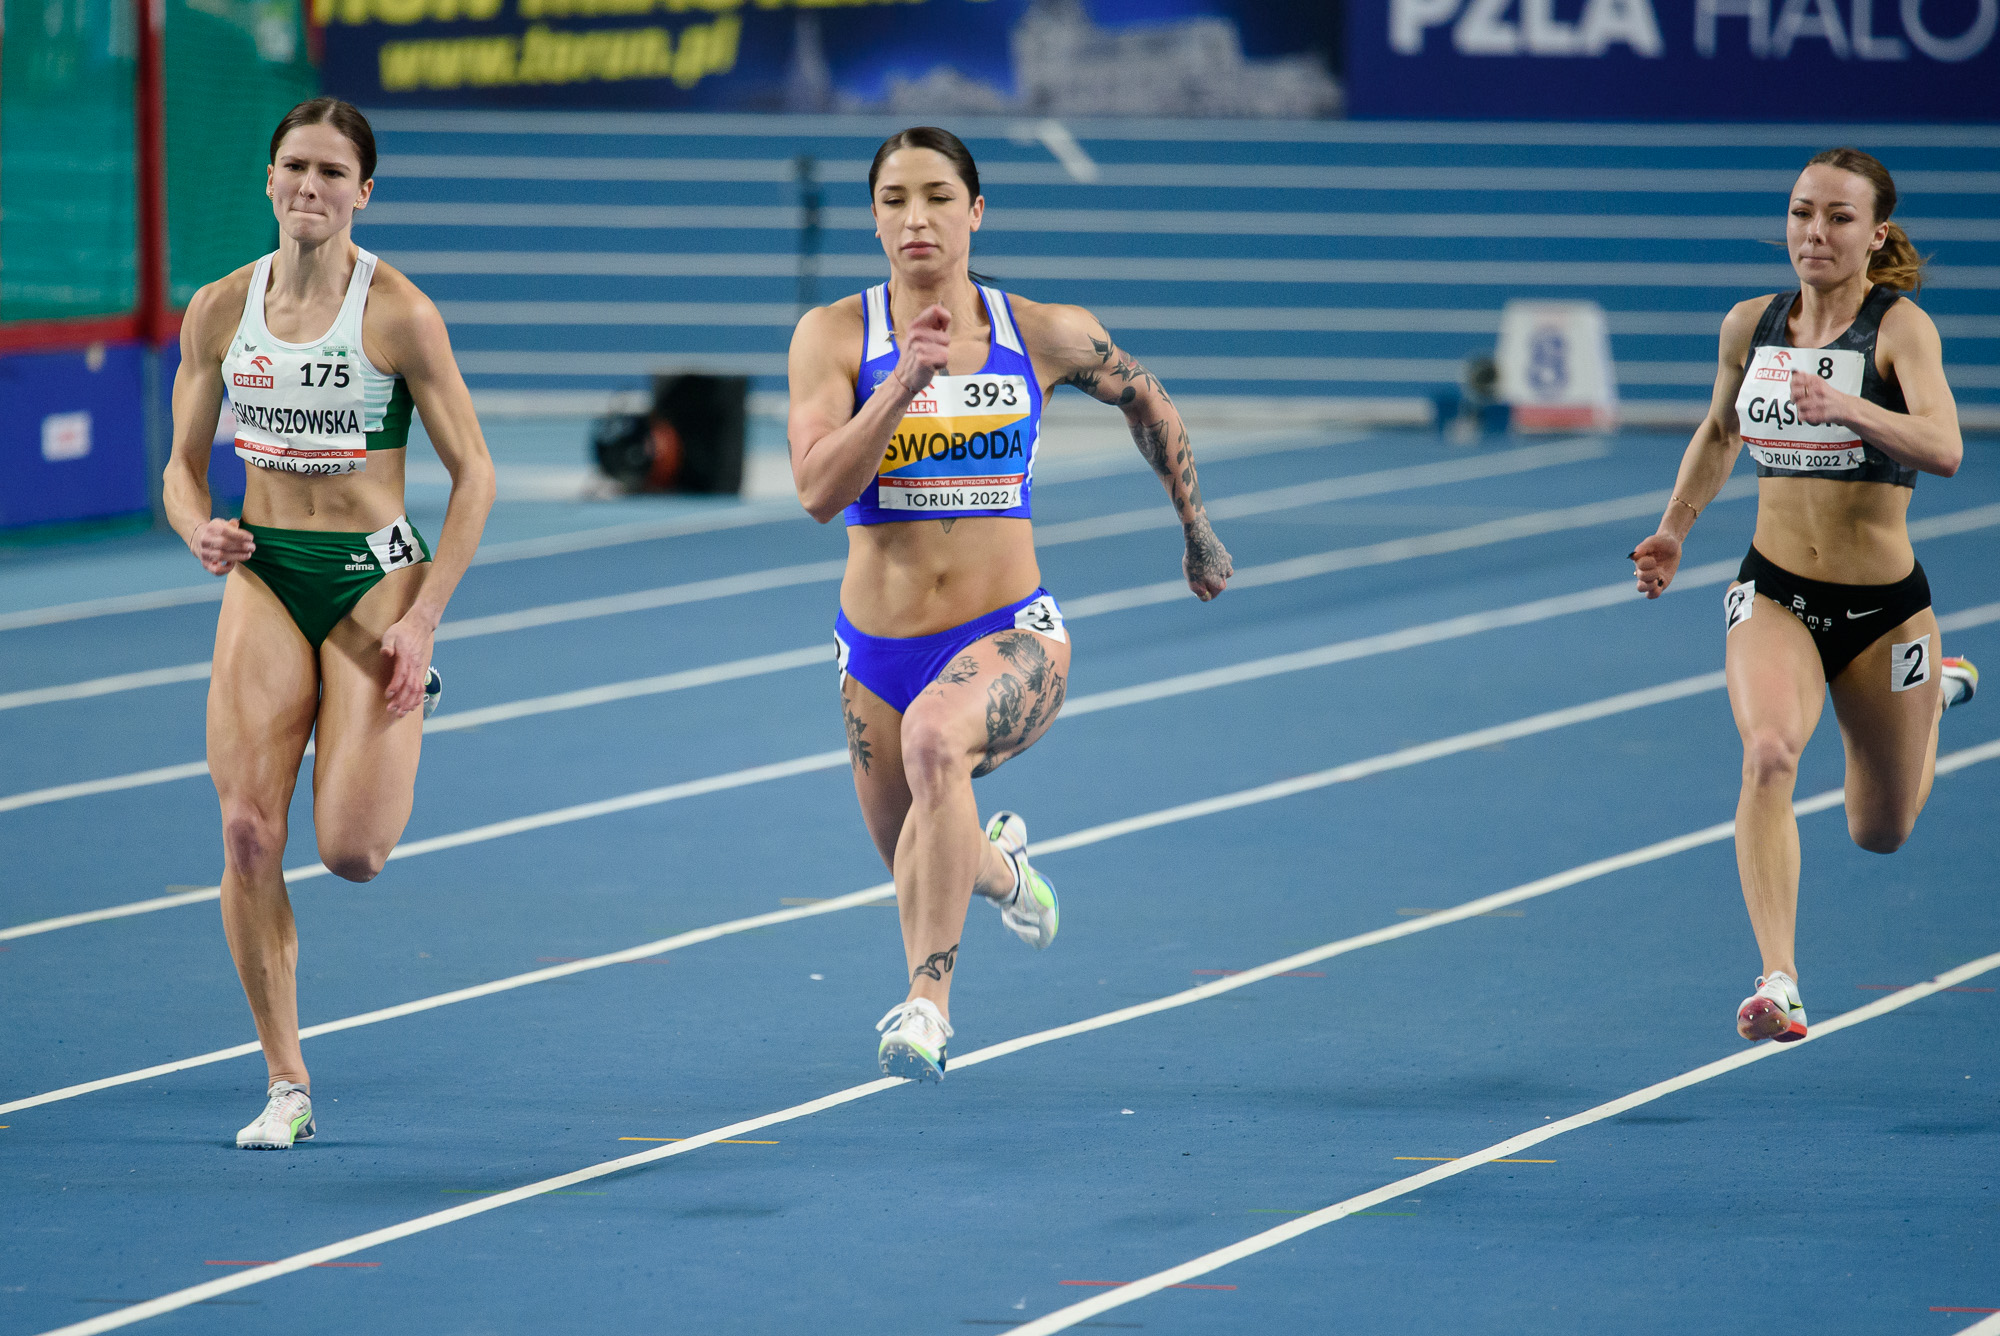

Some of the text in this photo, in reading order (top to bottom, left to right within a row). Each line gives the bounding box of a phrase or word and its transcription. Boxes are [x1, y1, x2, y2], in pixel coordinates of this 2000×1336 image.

[1388, 0, 1665, 56] PZLA
[235, 374, 272, 388] ORLEN
[300, 363, 350, 388] 175
[1756, 369, 1788, 380] ORLEN
[1817, 357, 1834, 380] 8
[964, 382, 1018, 408] 393
[234, 402, 360, 434] SKRZYSZOWSKA
[885, 430, 1023, 461] SWOBODA
[1761, 450, 1841, 467] TORUŃ 2022
[951, 478, 998, 486] MISTRZOSTWA
[905, 489, 1009, 507] TORUŃ 2022
[389, 525, 414, 564] 4
[345, 563, 375, 571] erima
[1728, 590, 1745, 630] 2
[1903, 643, 1924, 687] 2
